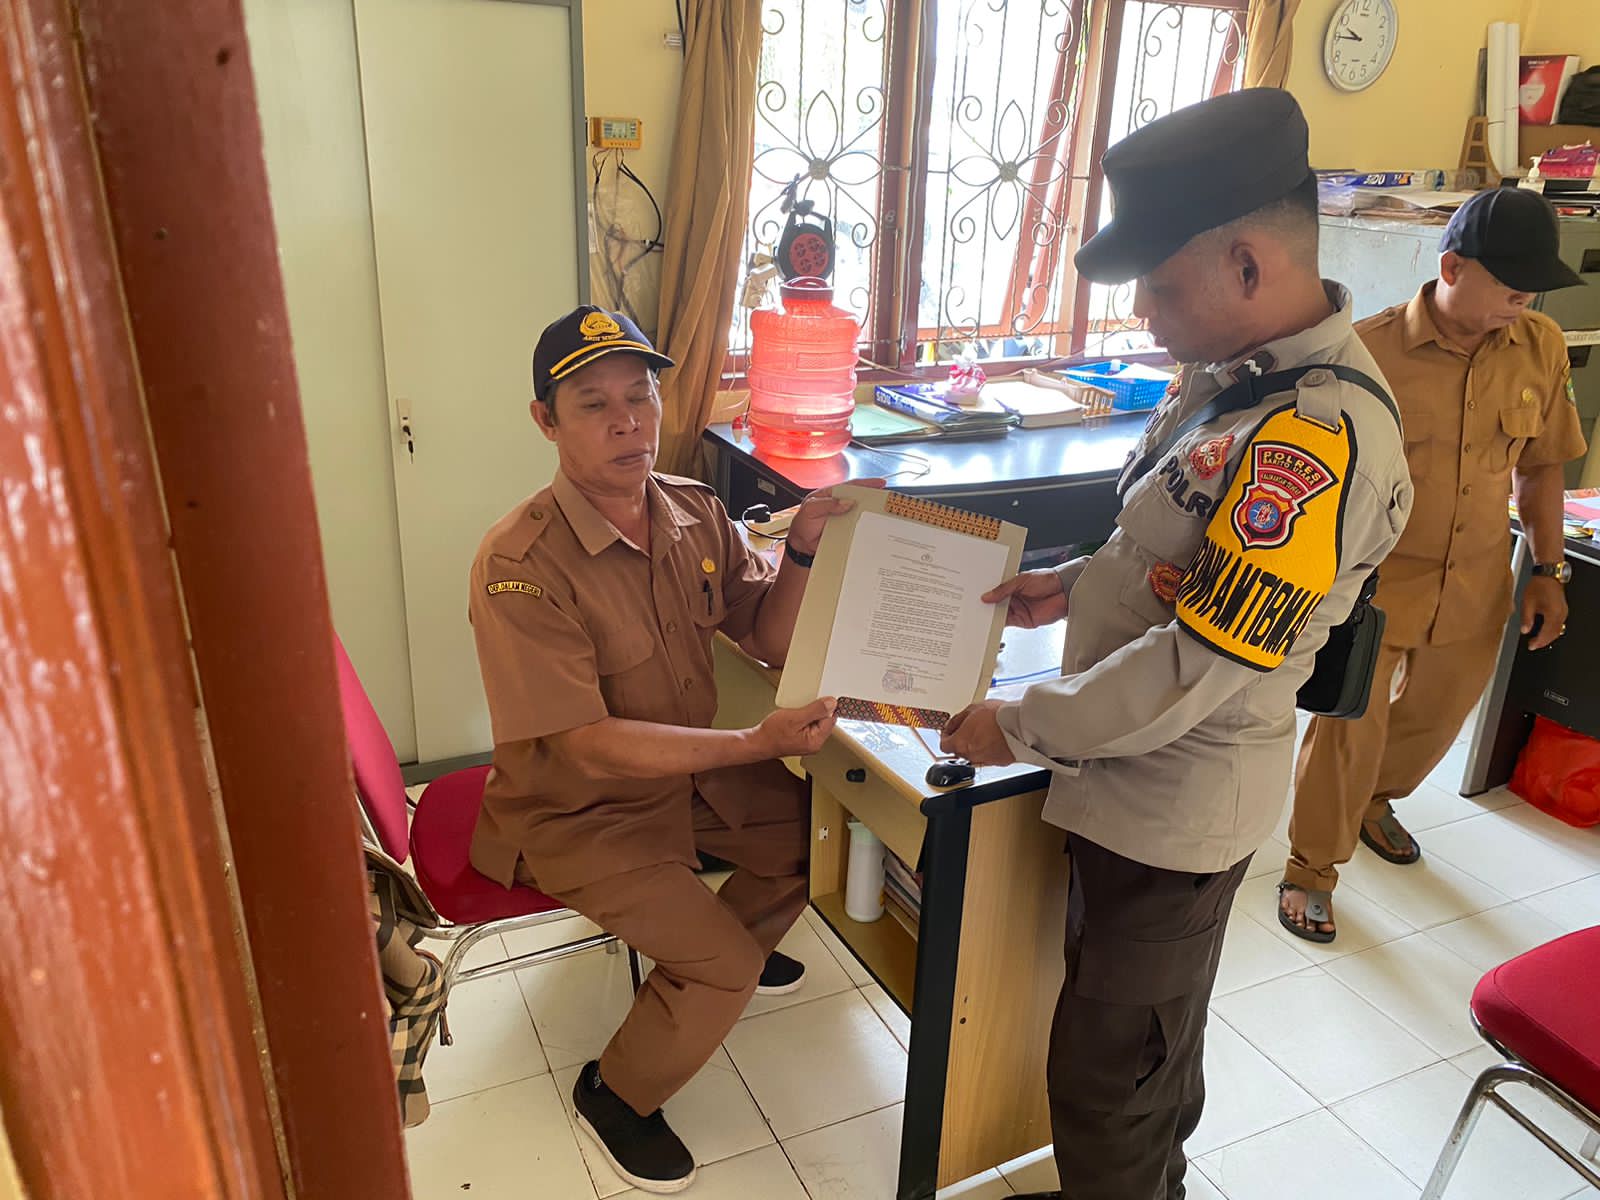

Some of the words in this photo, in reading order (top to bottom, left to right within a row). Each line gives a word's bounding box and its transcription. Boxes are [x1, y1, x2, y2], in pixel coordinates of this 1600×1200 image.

[1262, 451, 1321, 481] POLRES
[1262, 457, 1290, 468] BARITO
[1292, 466, 1315, 486] UTARA
